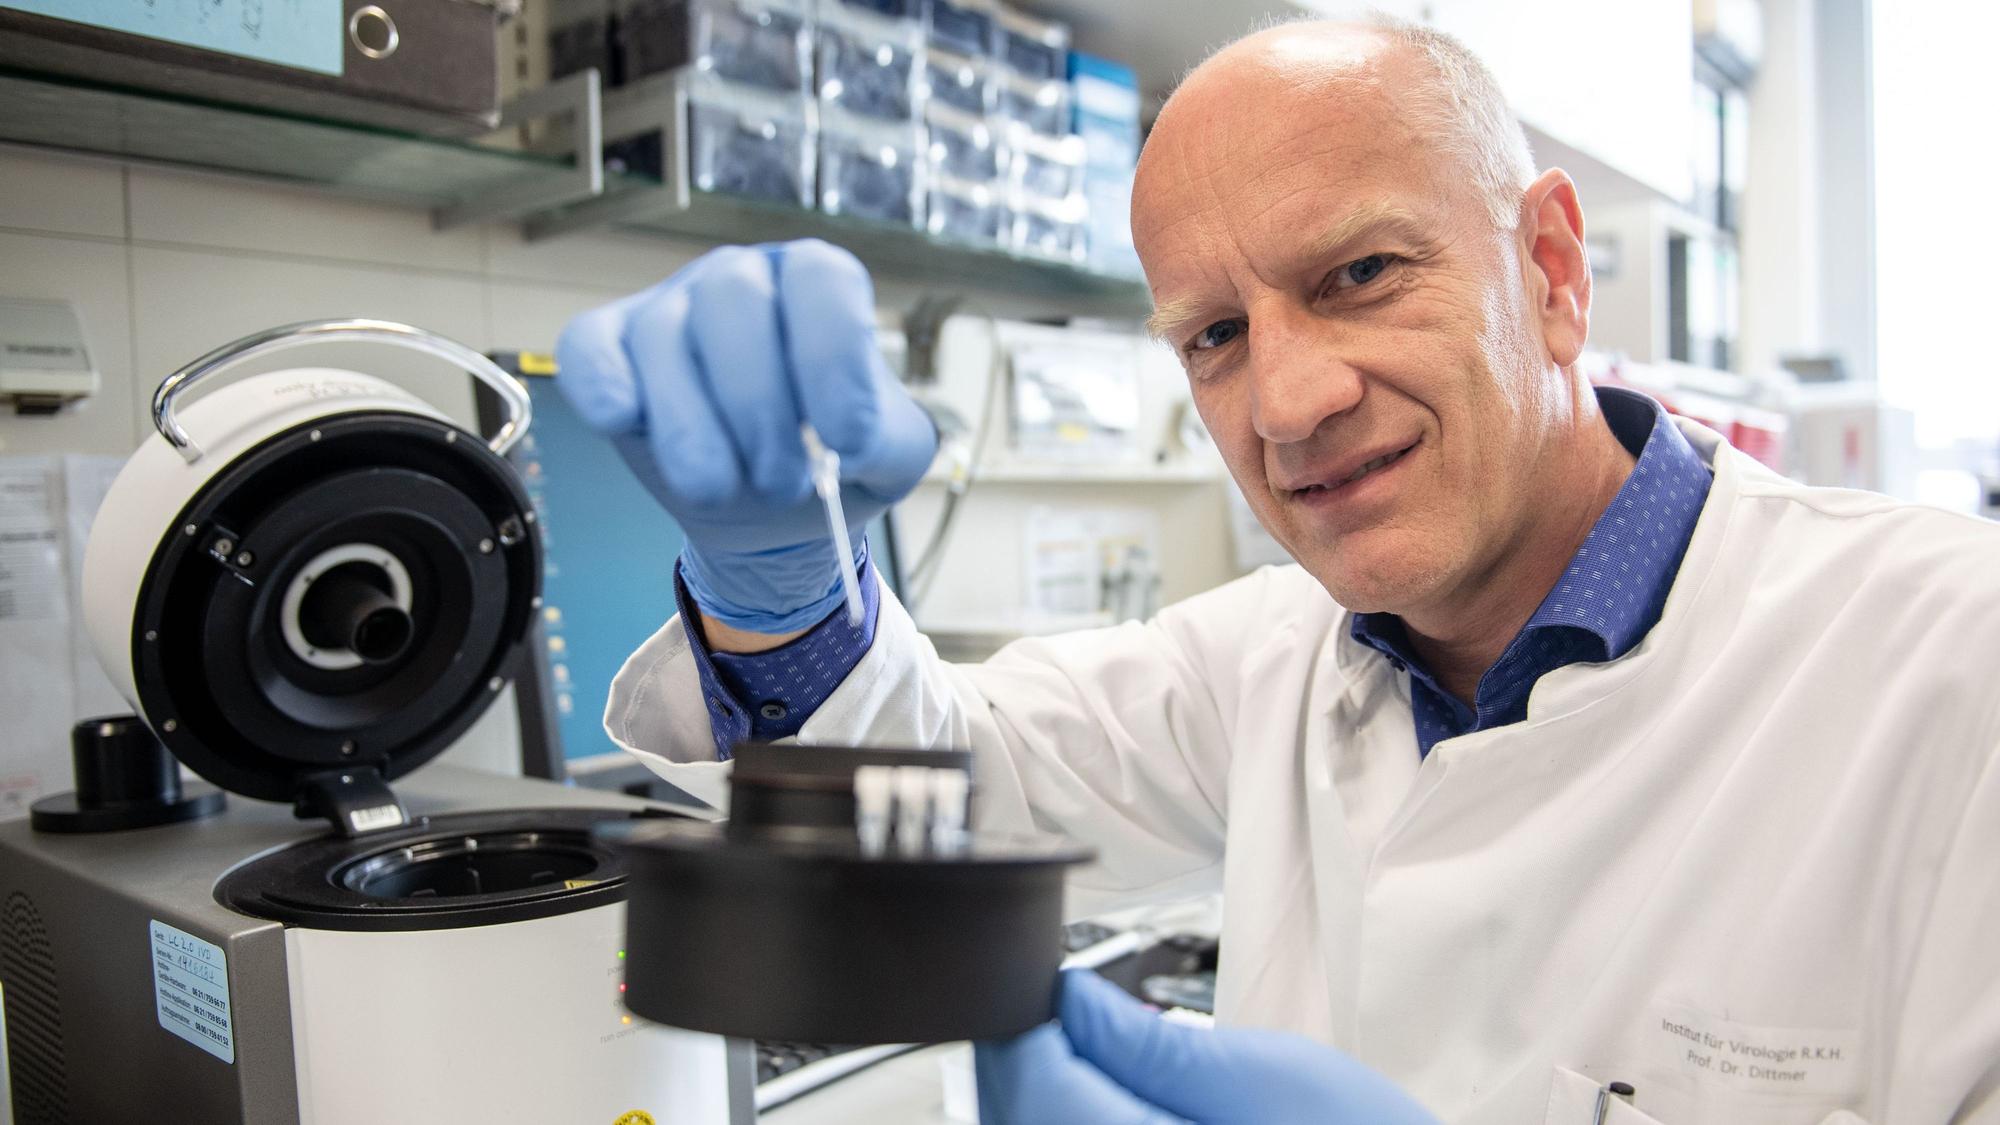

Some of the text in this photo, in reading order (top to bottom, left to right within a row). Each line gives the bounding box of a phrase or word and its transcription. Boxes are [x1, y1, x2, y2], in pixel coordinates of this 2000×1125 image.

[1661, 1017, 1845, 1063] Institut für Virologie R.K.H.
[1686, 1049, 1808, 1082] Prof. Dr. Dittmer
